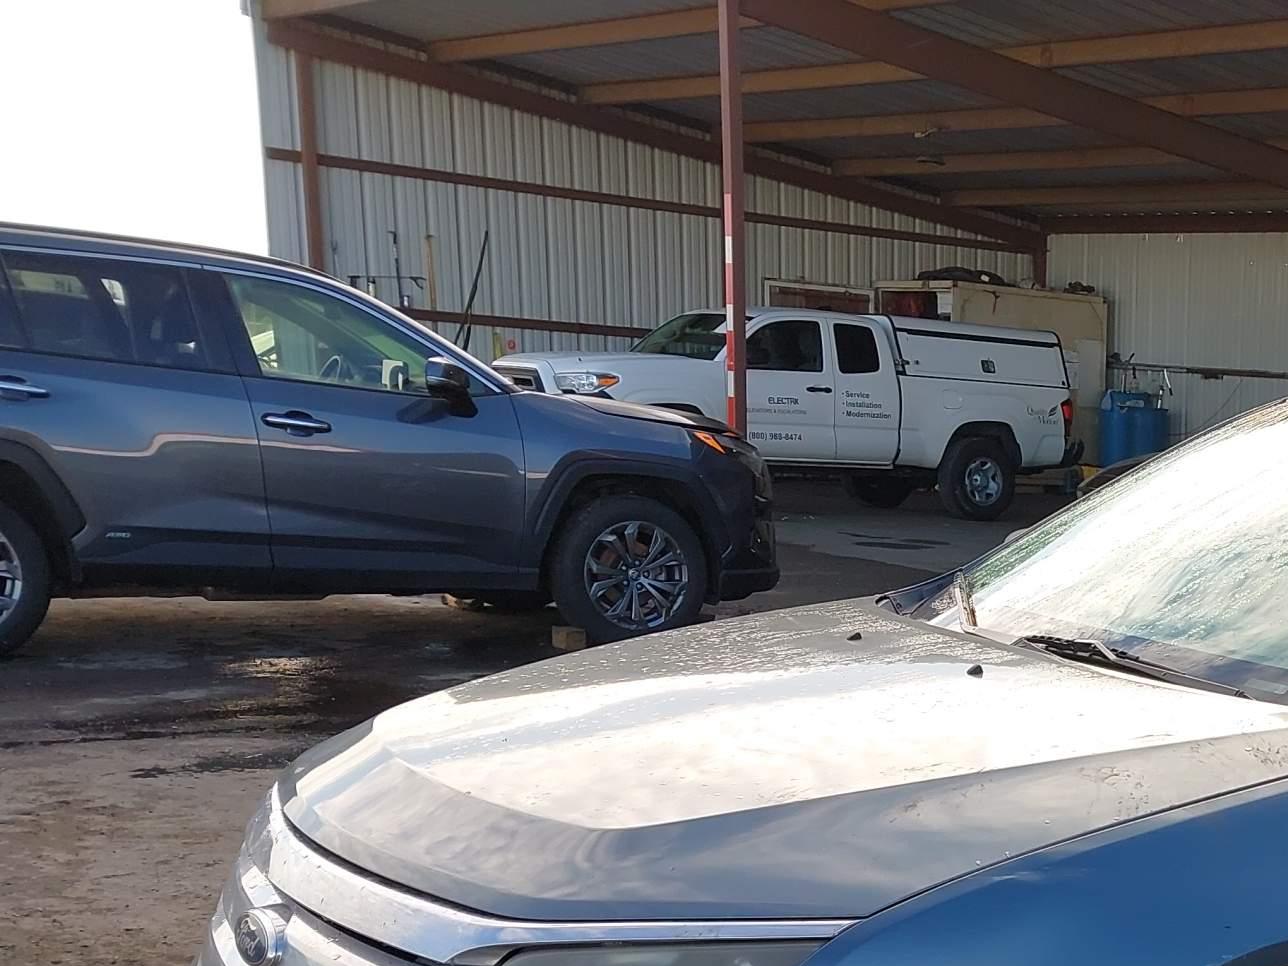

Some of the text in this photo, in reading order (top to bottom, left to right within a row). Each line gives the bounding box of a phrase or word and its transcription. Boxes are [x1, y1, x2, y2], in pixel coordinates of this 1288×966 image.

[845, 390, 870, 398] Service
[845, 401, 882, 409] Installation
[846, 411, 892, 419] Modernization
[749, 432, 767, 441] (800)
